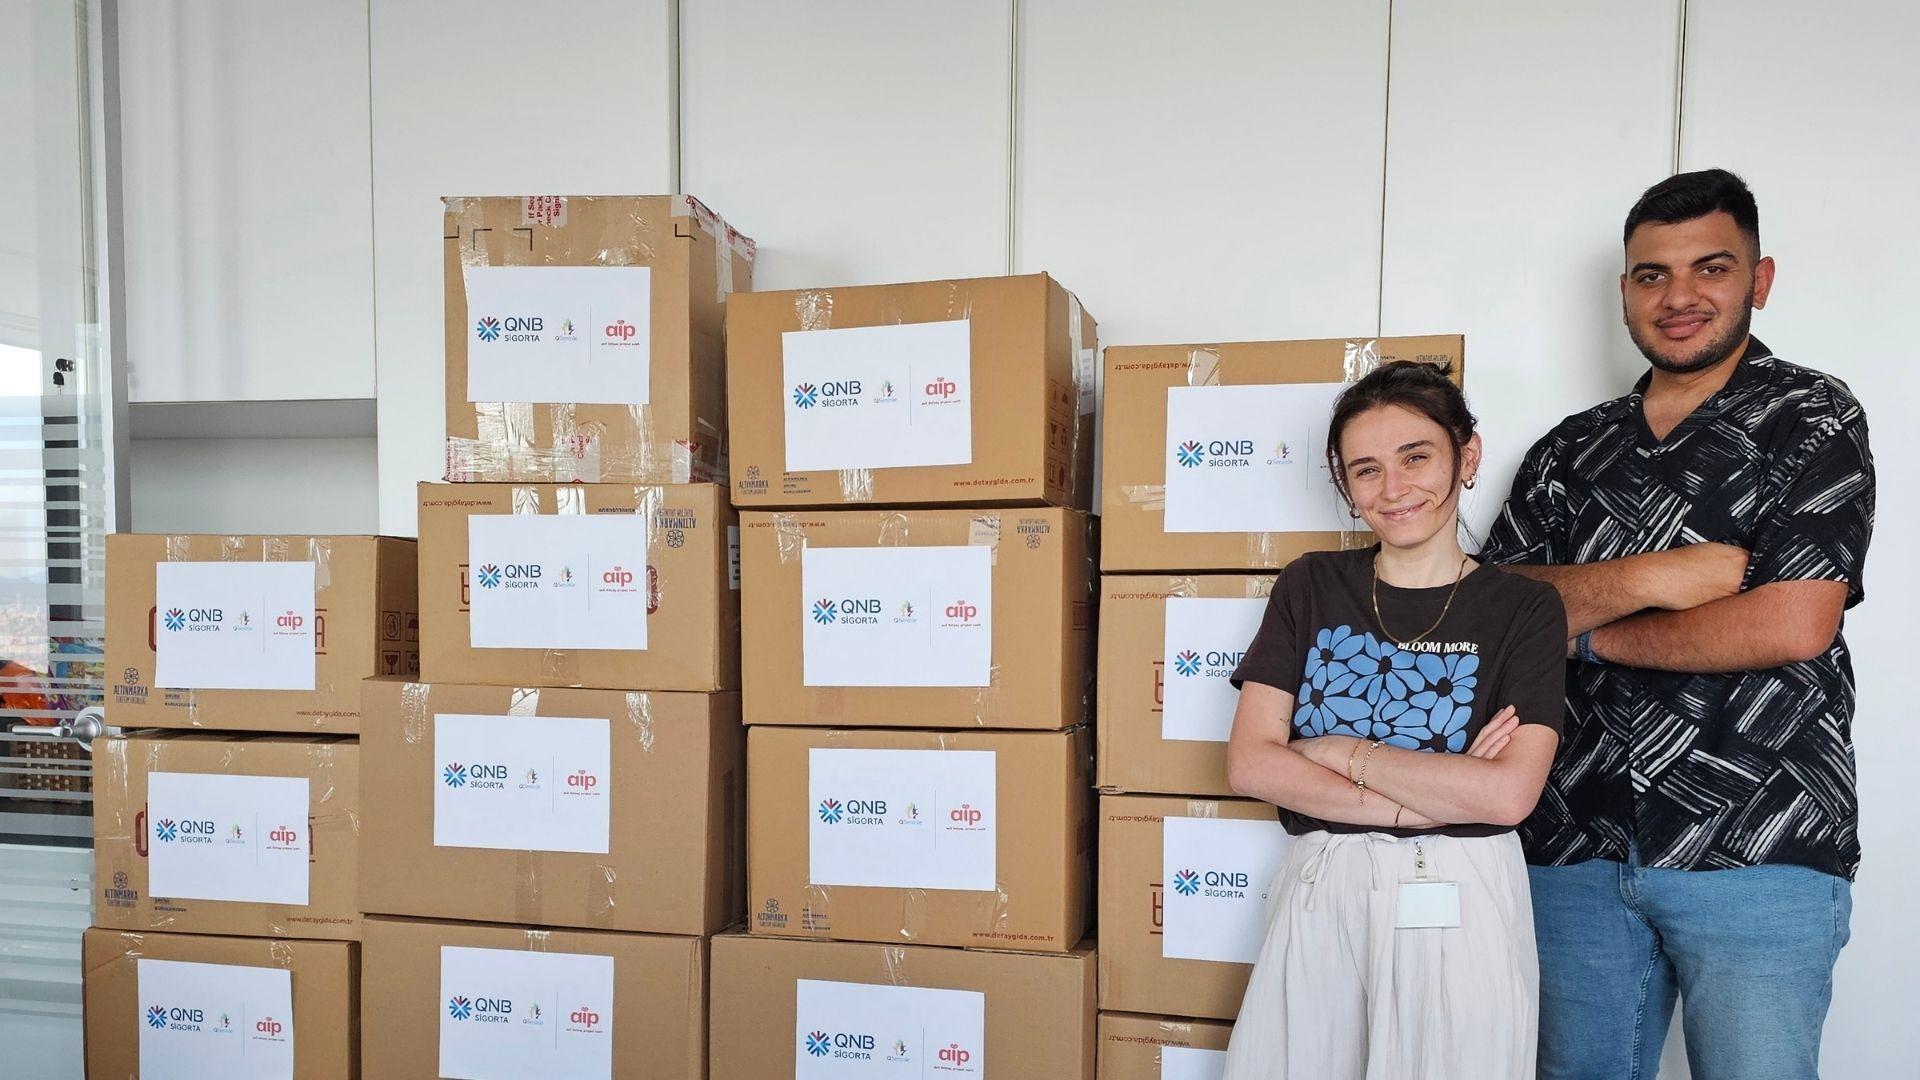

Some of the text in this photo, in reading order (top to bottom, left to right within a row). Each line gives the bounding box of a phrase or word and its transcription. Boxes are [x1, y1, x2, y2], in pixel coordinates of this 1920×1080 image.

[505, 317, 543, 331] QNB
[606, 320, 635, 340] aip
[822, 381, 861, 396] QNB
[925, 377, 956, 399] aip
[822, 398, 858, 408] SİGORTA
[1209, 441, 1253, 456] QNB
[1209, 458, 1249, 466] SİGORTA
[505, 565, 541, 578] QNB
[603, 567, 632, 587] aip
[841, 600, 881, 614] QNB
[946, 600, 977, 621] aip
[189, 608, 222, 622] QNB
[277, 611, 303, 630] aip
[841, 616, 877, 624] SİGORTA
[189, 624, 220, 632] SİGORTA
[1398, 641, 1479, 654] BLOOM MORE
[471, 765, 507, 779] QNB
[470, 780, 504, 789] SİGORTA
[568, 770, 596, 790] aip
[847, 800, 887, 815] QNB
[847, 816, 884, 825] SİGORTA
[950, 804, 981, 826] aip
[180, 820, 215, 834] QNB
[180, 835, 212, 843] SİGORTA
[270, 826, 296, 845] aip
[1205, 871, 1248, 887] QNB
[1204, 888, 1245, 898] SİGORTA
[475, 998, 512, 1013] QNB
[170, 1008, 203, 1022] QNB
[475, 1013, 509, 1024] SİGORTA
[570, 1007, 599, 1028] aip
[170, 1022, 201, 1032] SİGORTA
[256, 1017, 282, 1036] aip
[834, 1033, 875, 1049] QNB
[834, 1050, 871, 1061] SİGORTA
[938, 1044, 970, 1066] aip
